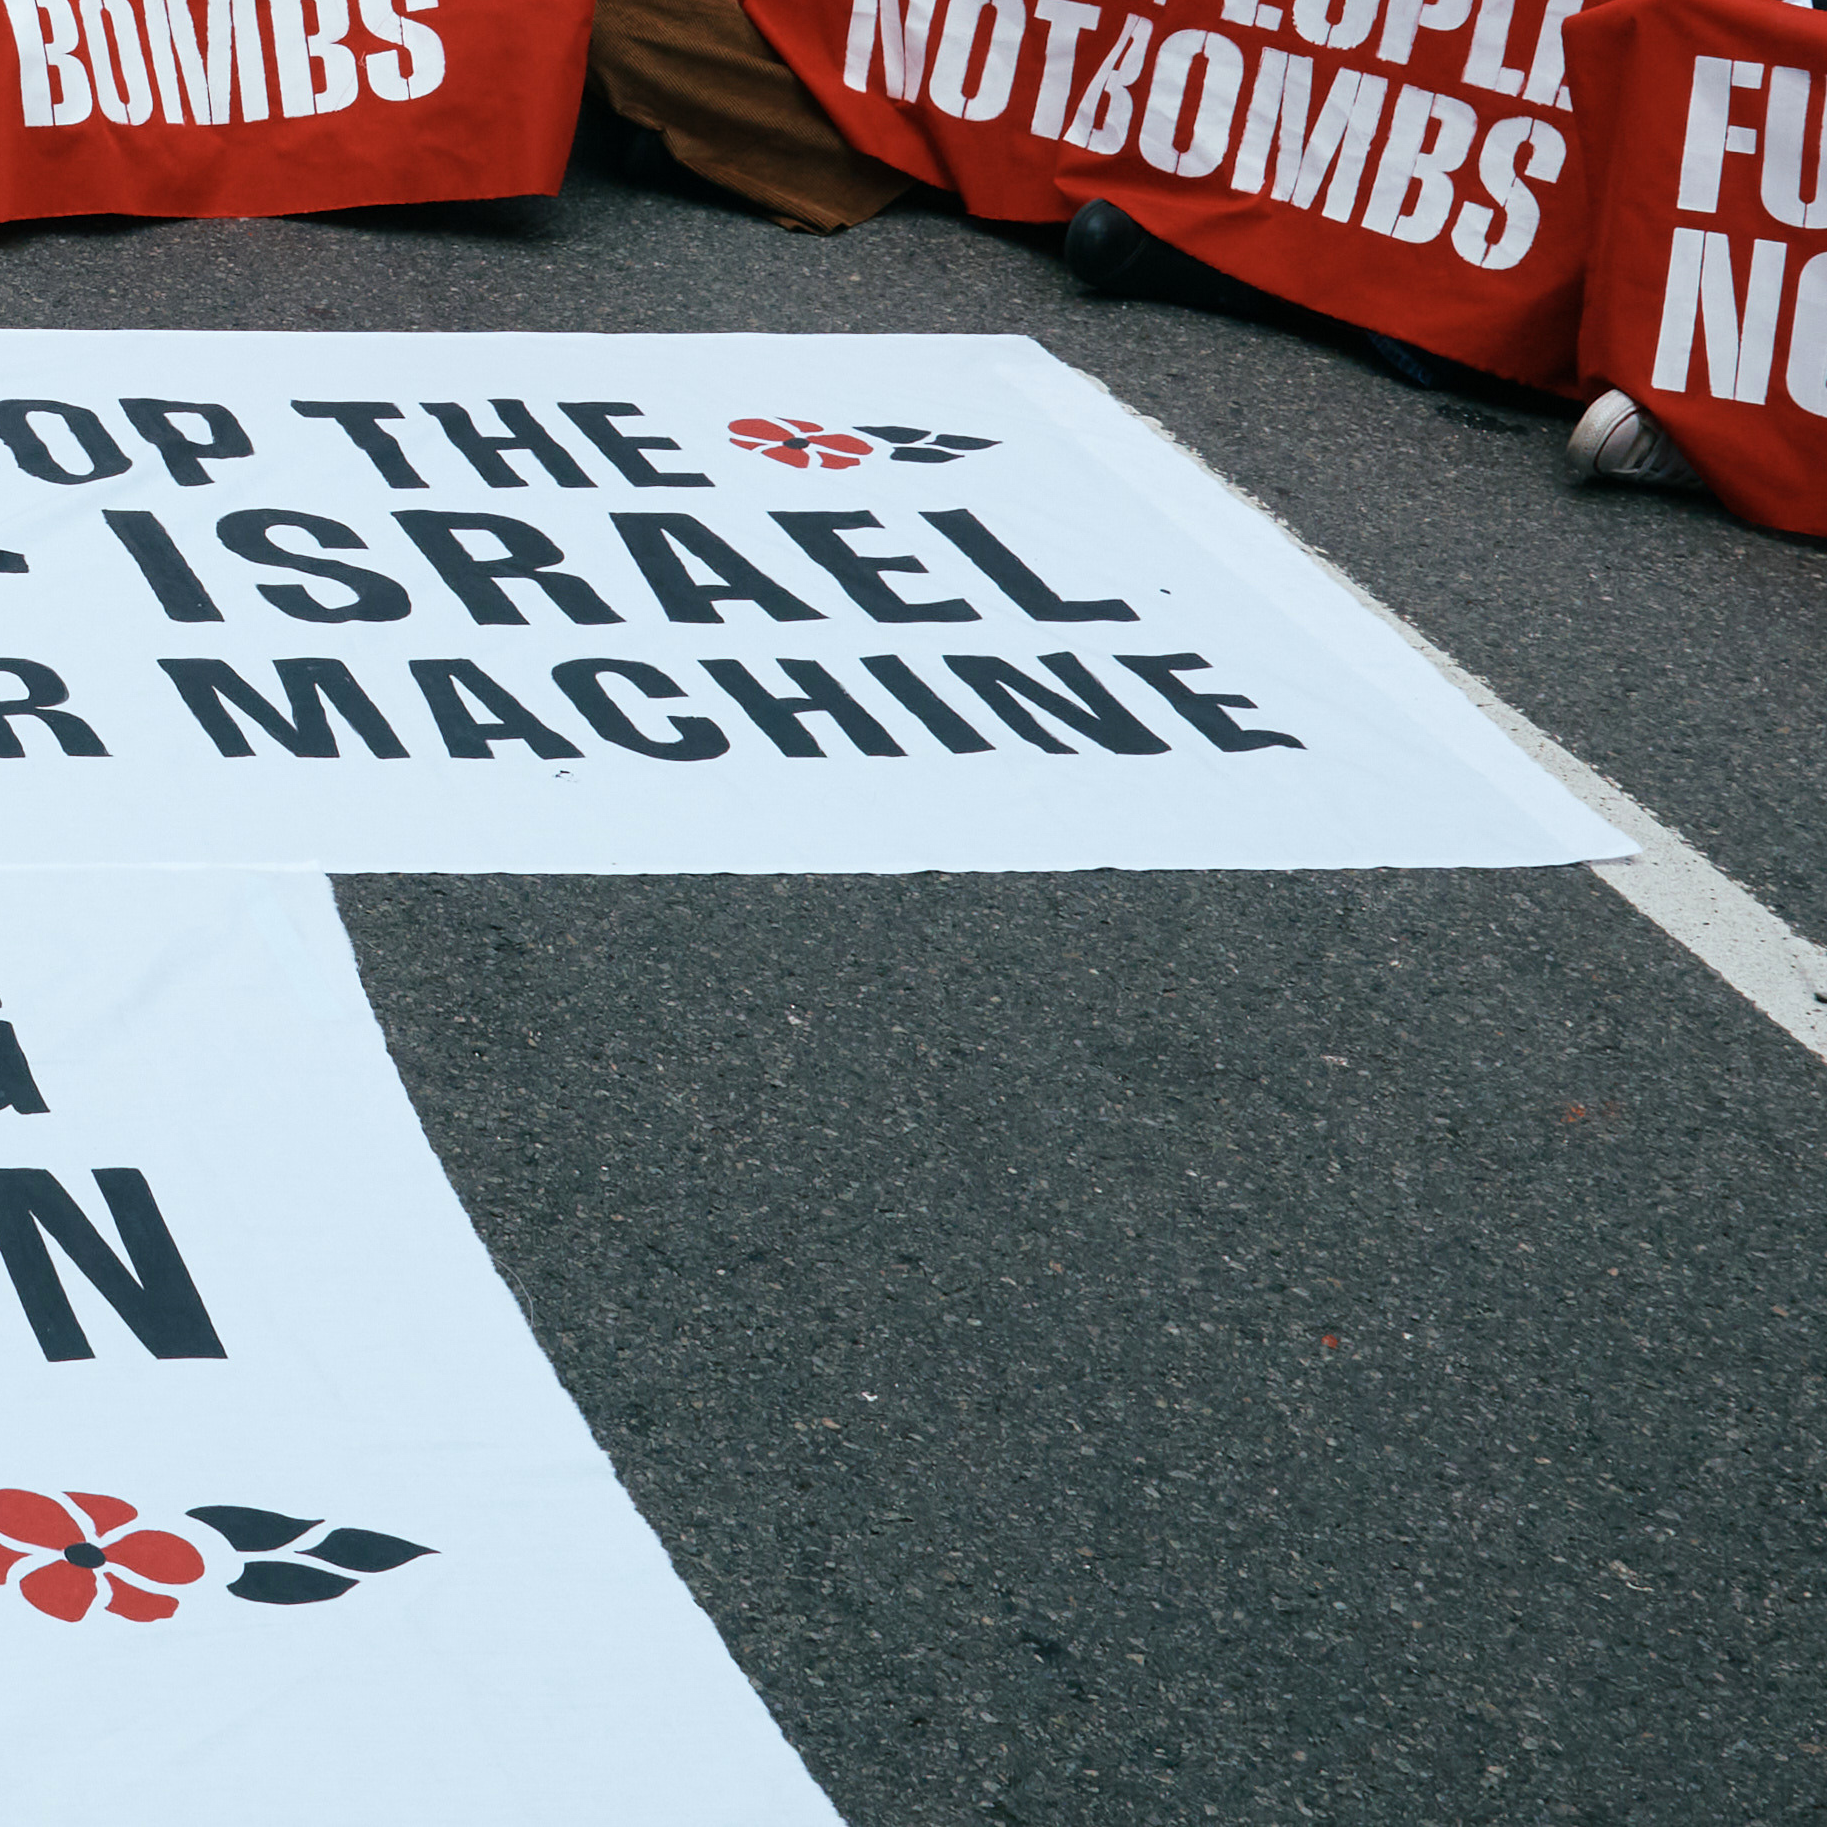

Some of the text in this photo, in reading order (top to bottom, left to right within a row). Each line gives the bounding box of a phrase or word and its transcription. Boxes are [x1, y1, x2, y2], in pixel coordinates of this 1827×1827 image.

[1064, 12, 1569, 271] BOMBS
[336, 399, 717, 492] THE
[101, 505, 1142, 626] ISRAEL
[155, 650, 1310, 764] MACHINE
